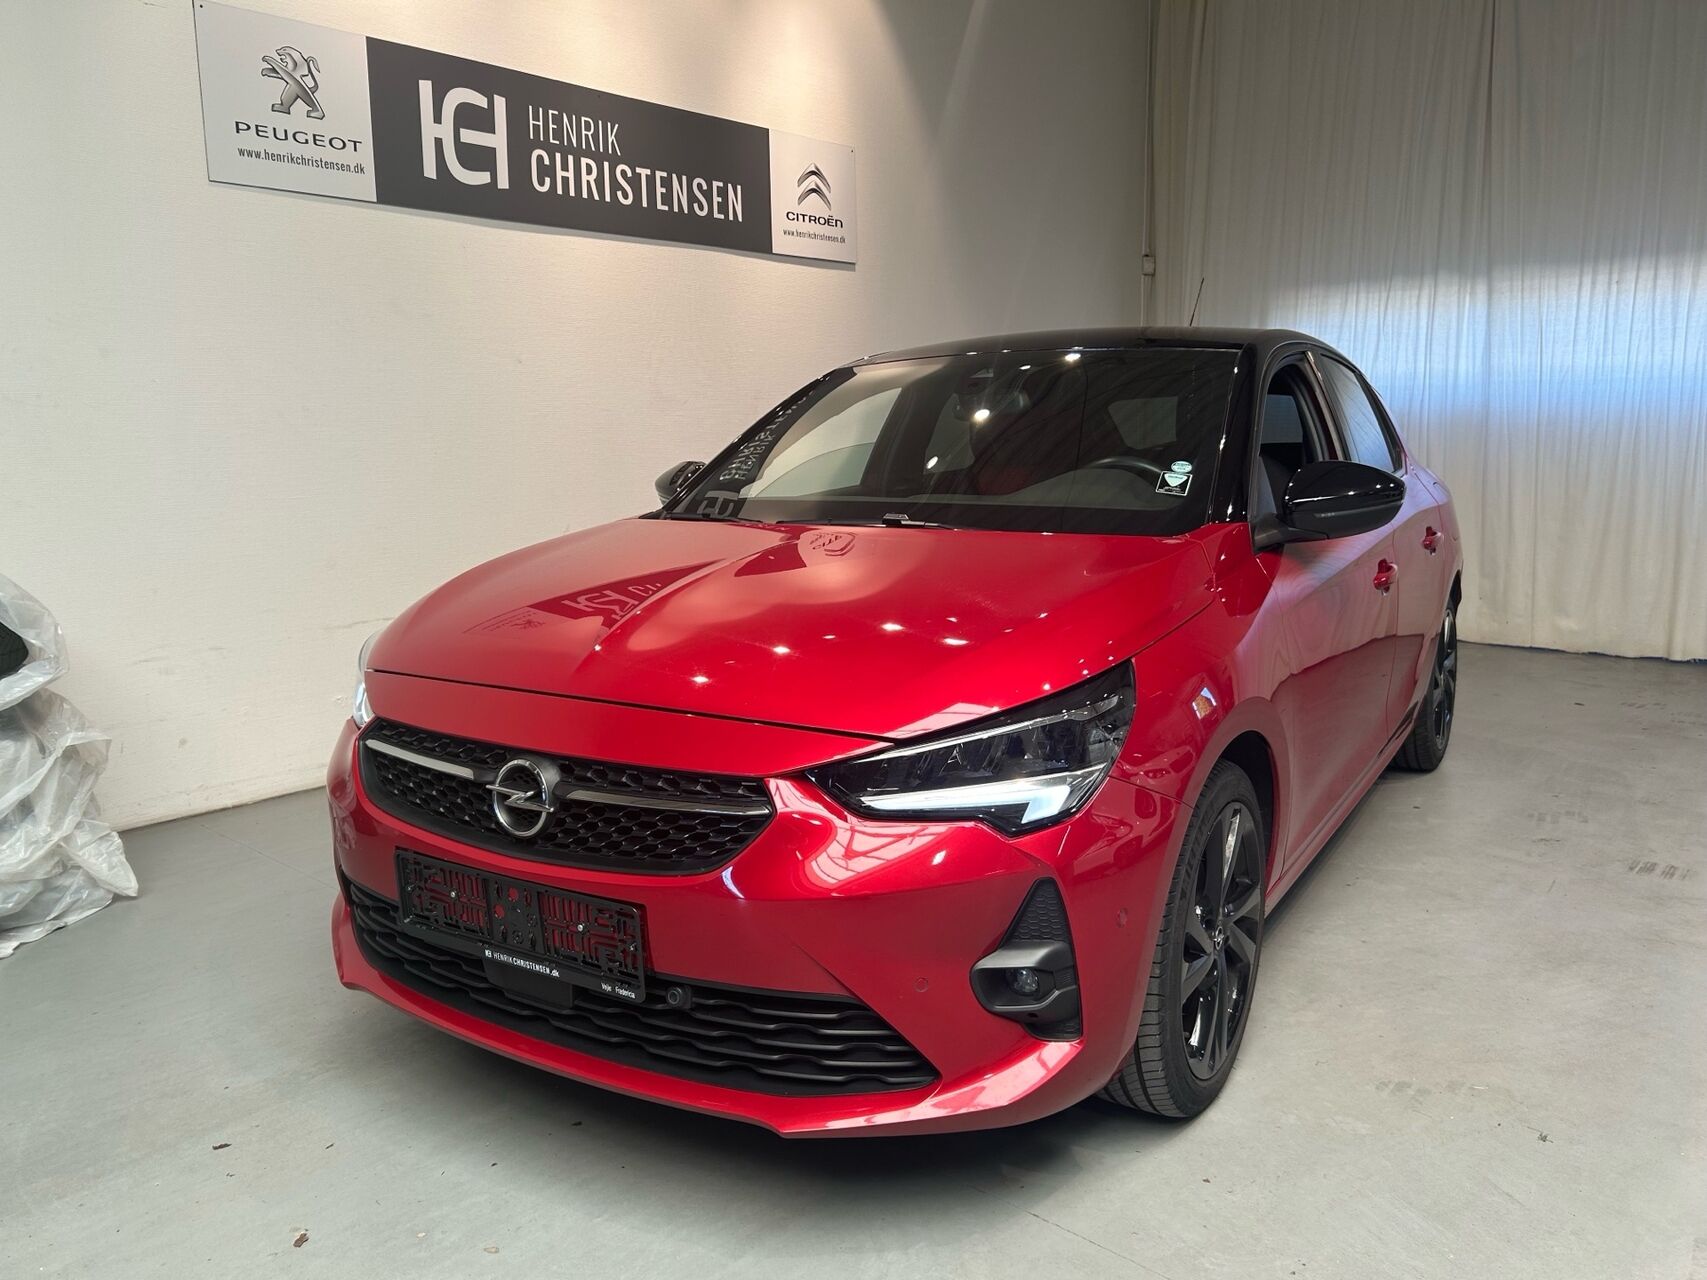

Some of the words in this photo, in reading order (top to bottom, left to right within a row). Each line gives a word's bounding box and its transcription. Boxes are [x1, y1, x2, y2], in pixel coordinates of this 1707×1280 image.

[235, 120, 363, 153] PEUGEOT
[528, 105, 622, 156] HENRIK
[237, 147, 366, 175] www.henrikchristensen.dk
[530, 148, 743, 223] CHRISTENSEN
[786, 211, 844, 228] CITROËN
